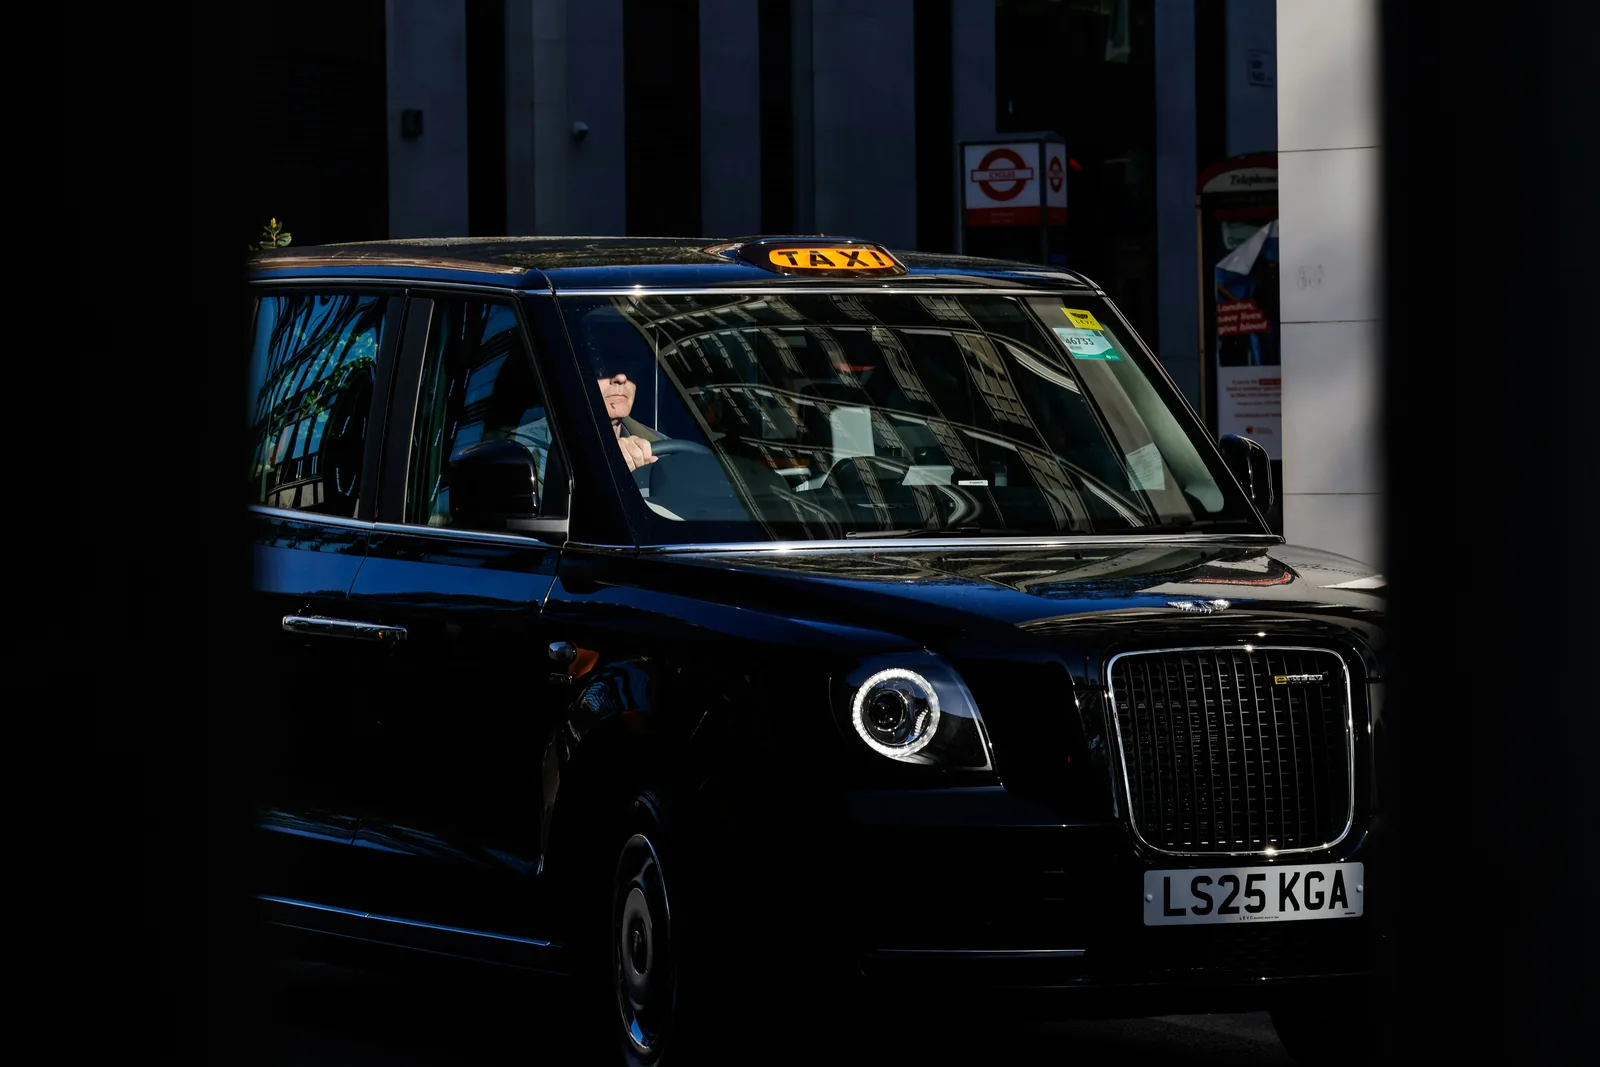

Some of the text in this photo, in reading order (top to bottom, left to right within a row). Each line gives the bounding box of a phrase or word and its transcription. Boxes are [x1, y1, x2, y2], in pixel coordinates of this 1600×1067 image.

[989, 171, 1015, 179] CYCLES
[777, 250, 886, 267] TAXI
[1239, 320, 1268, 331] blood
[1065, 337, 1095, 346] 46733
[1163, 869, 1349, 917] LS25 KGA
